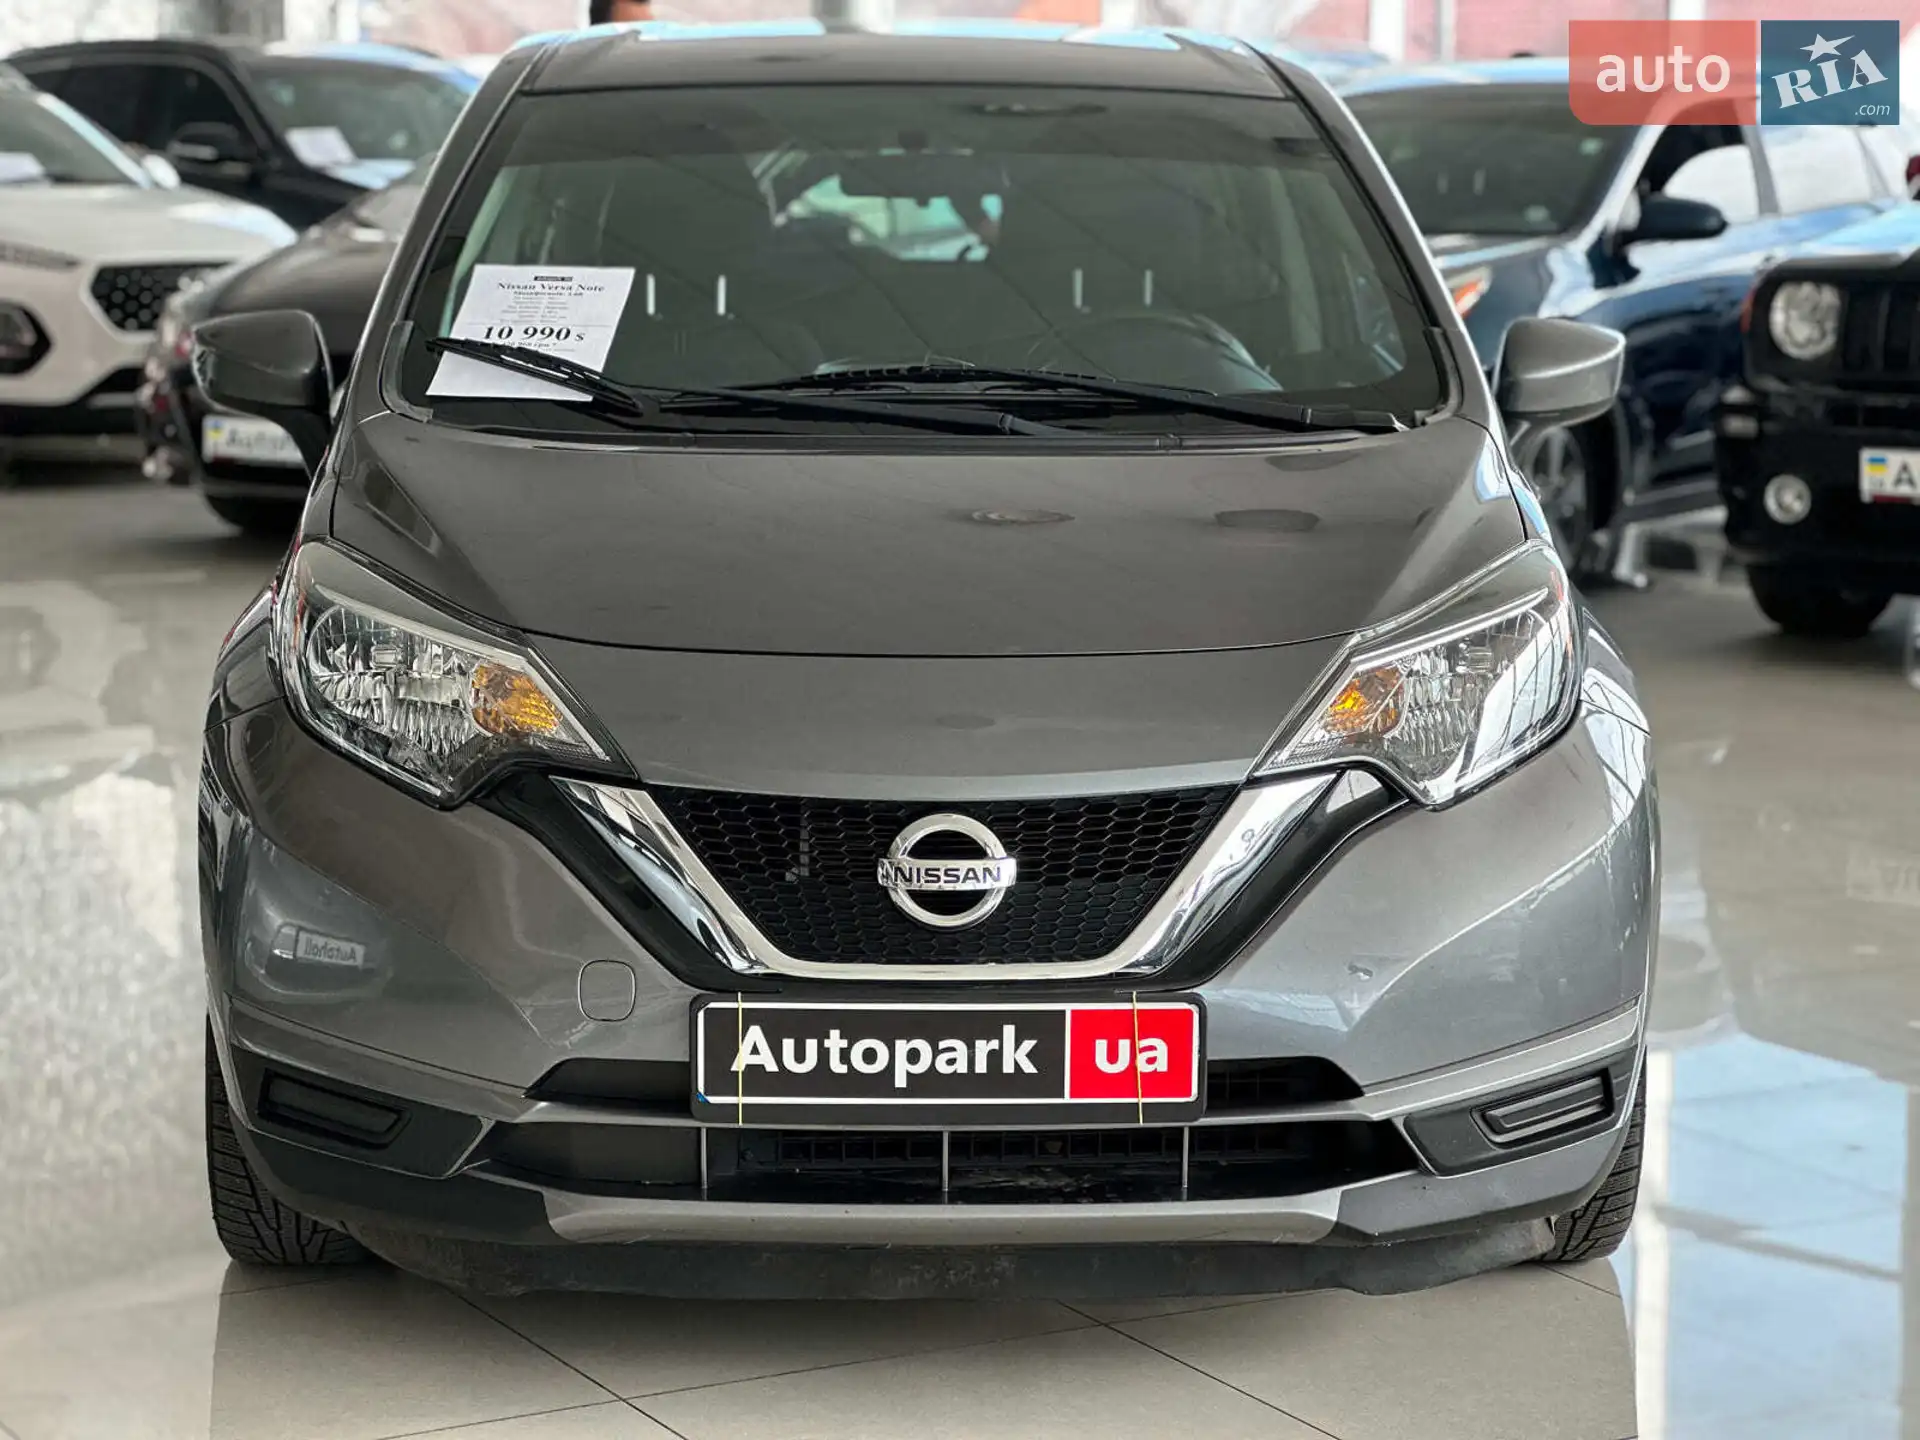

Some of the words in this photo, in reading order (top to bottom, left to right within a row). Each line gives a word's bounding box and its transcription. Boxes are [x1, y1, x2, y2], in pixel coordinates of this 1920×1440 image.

[497, 282, 536, 290] Nissan
[539, 283, 572, 291] Versa
[576, 284, 605, 292] Note
[484, 325, 513, 340] 10
[521, 326, 571, 341] 990
[893, 866, 1001, 884] NISSAN
[730, 1024, 1039, 1088] Autopark
[1094, 1037, 1169, 1074] ua
